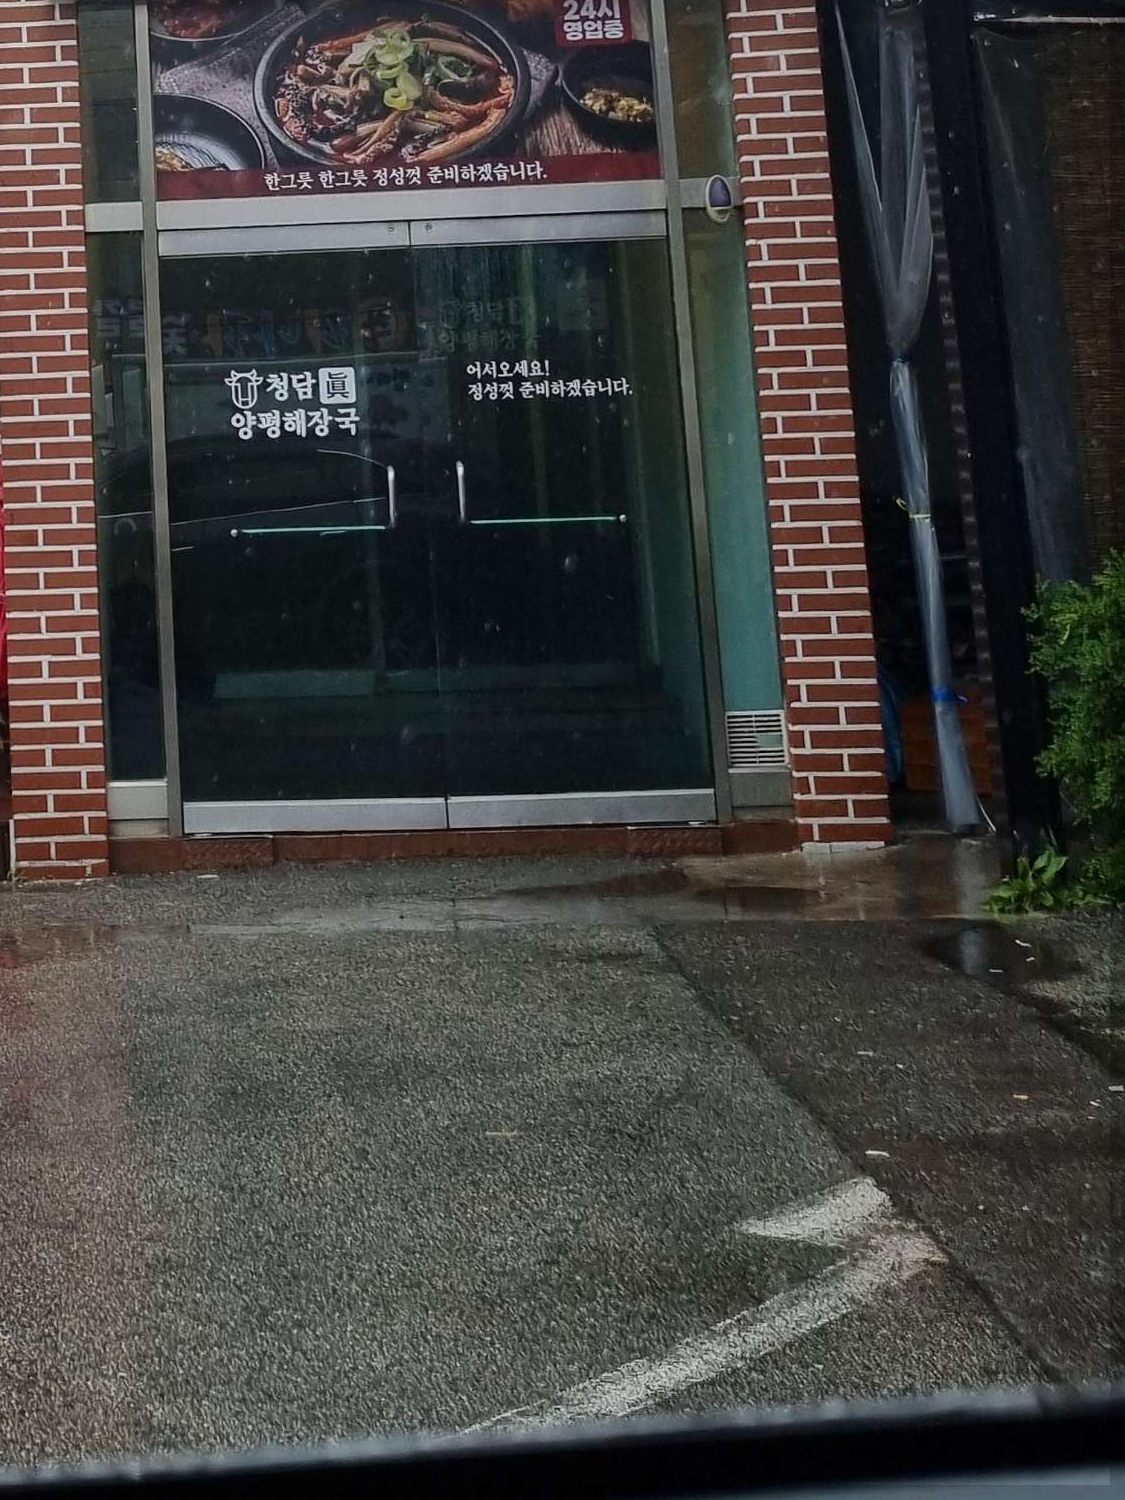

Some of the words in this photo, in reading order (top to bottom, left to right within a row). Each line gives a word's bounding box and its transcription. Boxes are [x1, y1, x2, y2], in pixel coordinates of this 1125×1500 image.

[563, 20, 624, 41] 영업중
[263, 171, 315, 191] 한그릇
[317, 169, 368, 189] 한그릇
[372, 166, 423, 187] 정성껏
[426, 160, 549, 184] 준비하겠습니다.
[466, 359, 550, 380] 어서오세요!
[264, 371, 317, 402] 청담
[324, 369, 350, 401] 眞
[467, 380, 515, 401] 정성껏
[518, 376, 634, 400] 준비하겠습니다.
[229, 406, 362, 440] 양평해장국
